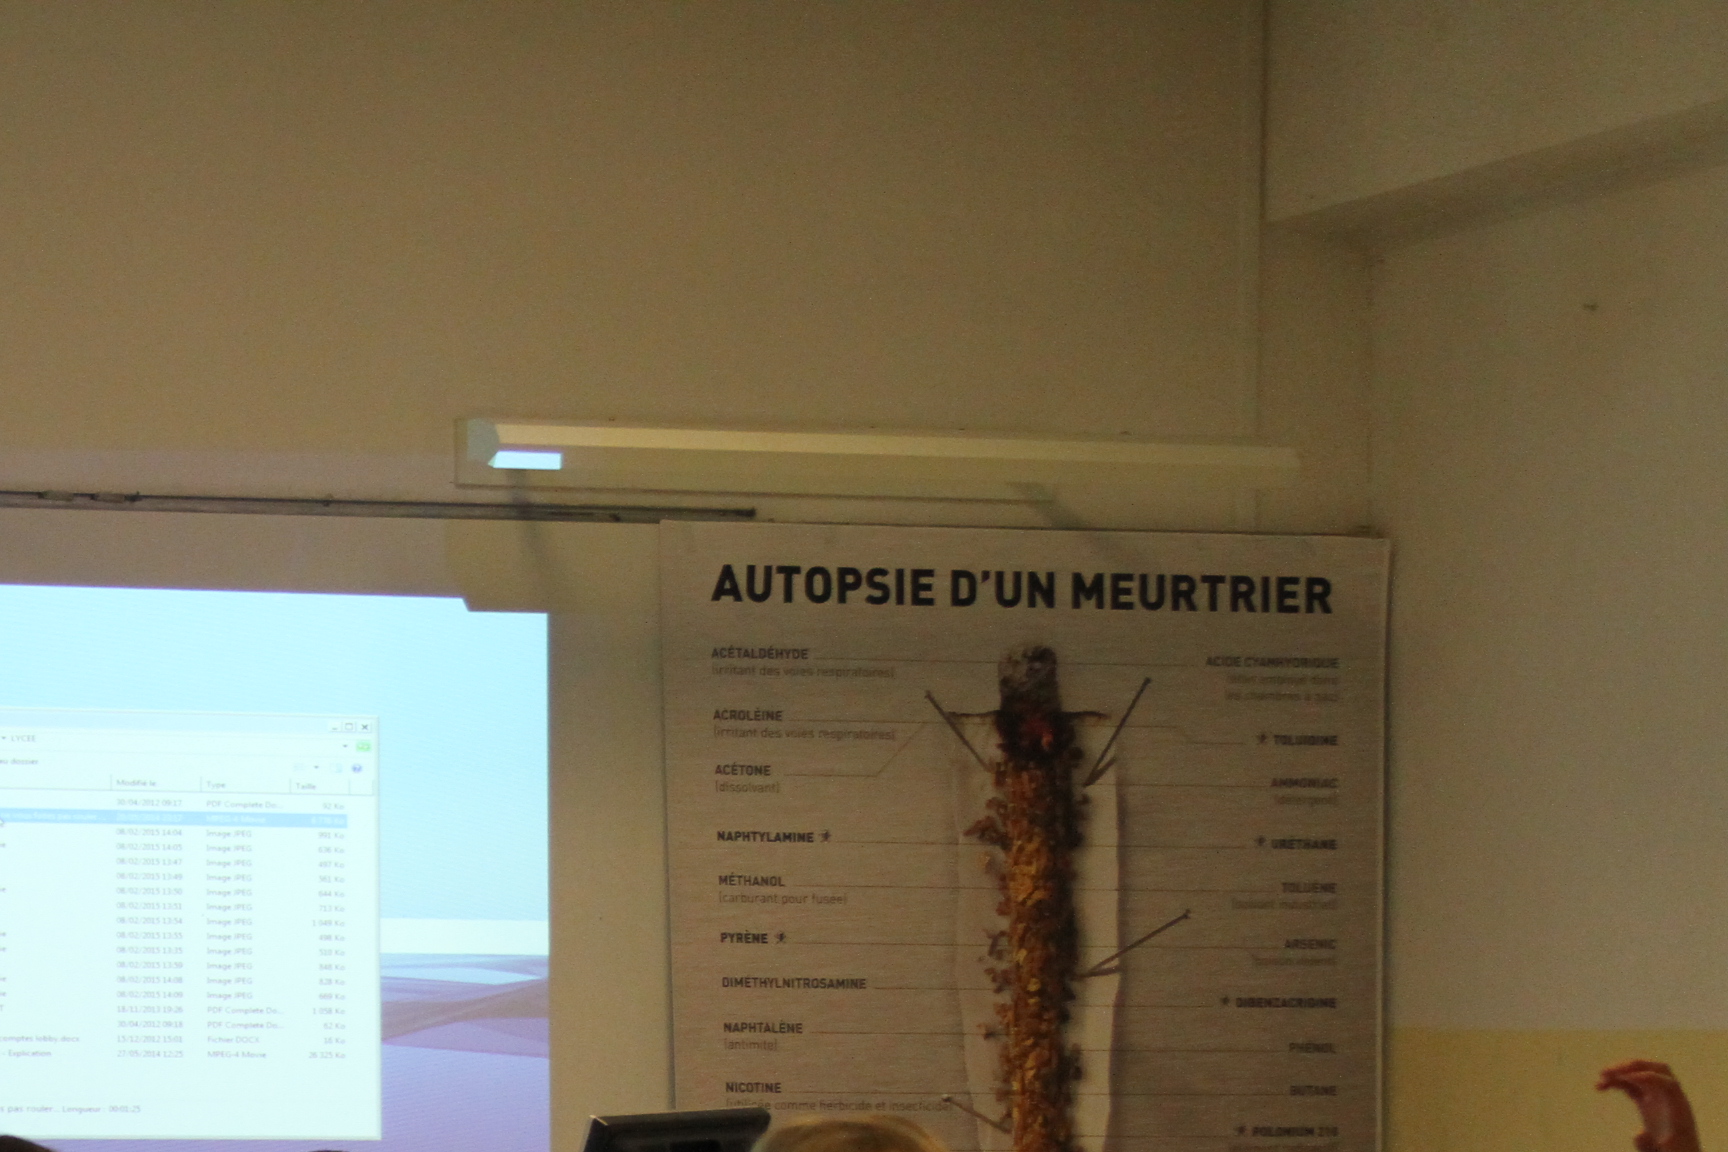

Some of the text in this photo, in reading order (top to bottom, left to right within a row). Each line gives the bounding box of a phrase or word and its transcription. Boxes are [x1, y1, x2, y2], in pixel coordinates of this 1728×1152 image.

[711, 564, 1333, 614] AUTOPSIE D'UN MEURTRIER
[711, 645, 809, 660] ACÉTALDÉHYDE
[759, 664, 780, 676] des
[761, 725, 781, 738] des
[10, 734, 36, 743] LYCEE
[11, 756, 39, 766] dossier
[714, 761, 771, 776] ACÉTONE
[206, 780, 226, 790] Type
[295, 781, 317, 791] Taille
[206, 800, 264, 811] PDF Complete
[206, 830, 253, 839] Image JPEG
[717, 831, 815, 843] NAPHTYLAMINE
[206, 844, 253, 854] Image JPEG
[206, 859, 253, 869] Image JPEG
[206, 874, 253, 883] Image JPEG
[718, 872, 786, 887] MÉTHANOL
[206, 888, 253, 898] Image JPEG
[206, 903, 253, 913] Image JPEG
[206, 918, 253, 928] Image JPEG
[206, 933, 253, 943] Image JPEG
[720, 929, 769, 944] PYRÈNE
[206, 948, 253, 957] Image JPEG
[206, 962, 253, 972] Image JPEG
[206, 977, 253, 987] Image JPEG
[206, 992, 253, 1002] Image JPEG
[206, 1006, 264, 1017] PDF Complete
[206, 1021, 264, 1031] PDF Complete
[723, 1020, 803, 1034] NAPHTALÈNE
[8, 1049, 52, 1060] Explication
[725, 1082, 782, 1094] NICOTINE
[7, 1105, 24, 1115] pas
